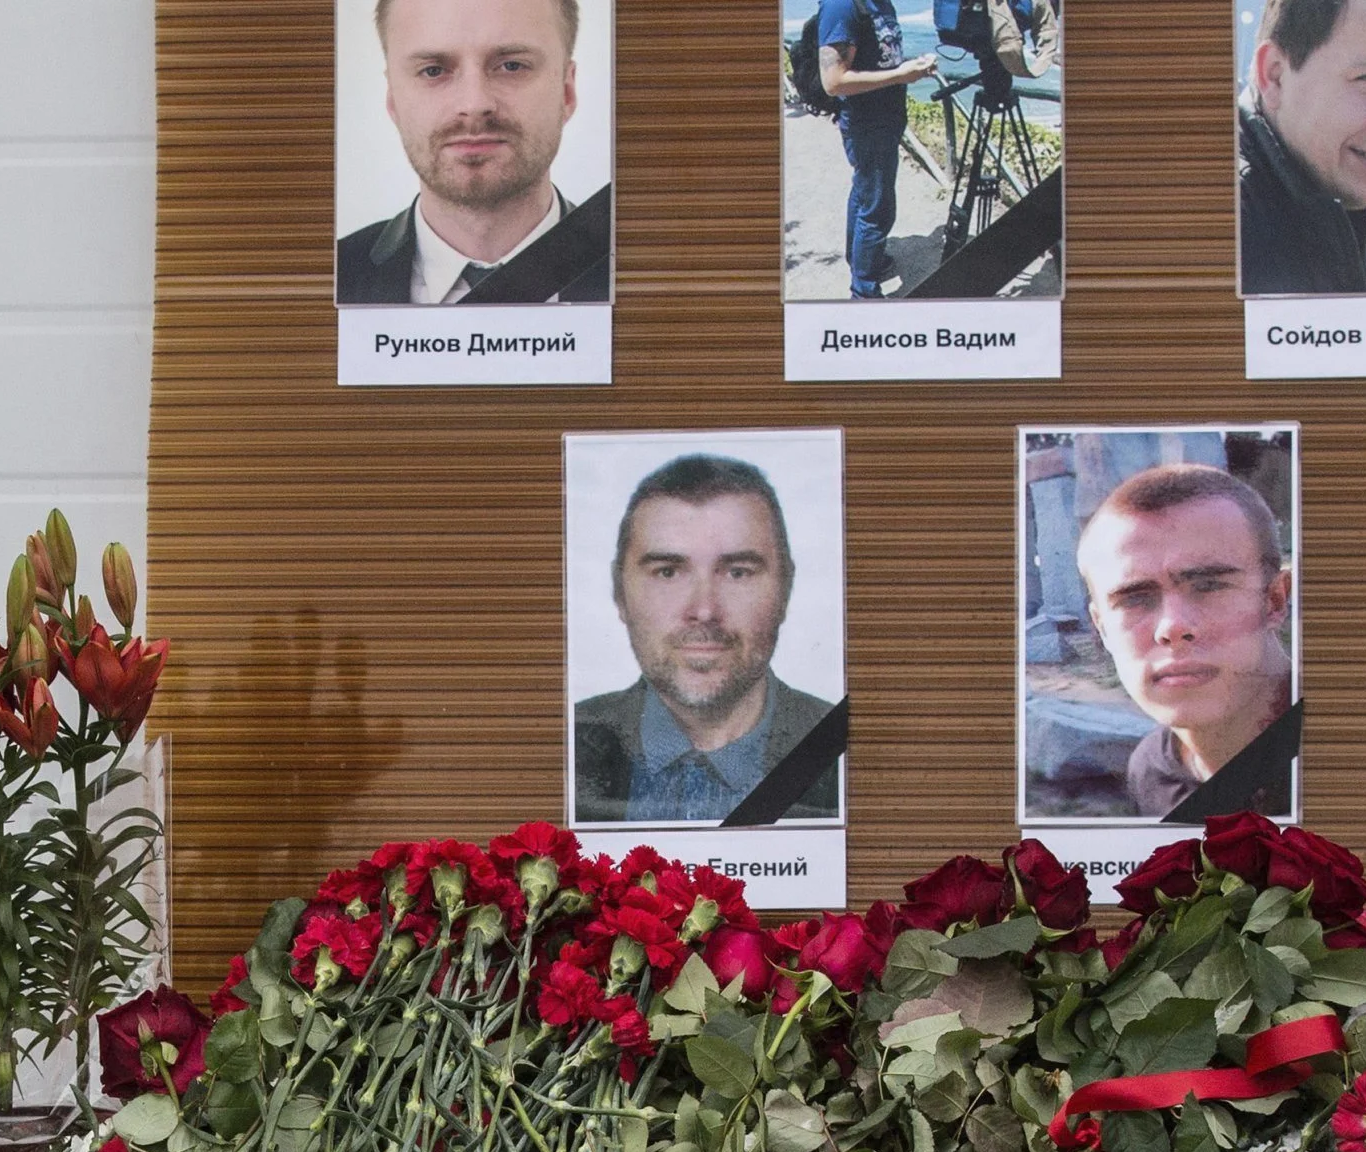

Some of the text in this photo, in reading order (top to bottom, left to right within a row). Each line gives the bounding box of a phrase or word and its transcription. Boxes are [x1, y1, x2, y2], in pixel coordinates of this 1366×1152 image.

[375, 332, 576, 358] Рунков Дмитрий
[820, 328, 1016, 353] Денисов Вадим
[1267, 325, 1363, 348] Сойдов
[707, 856, 808, 877] Евгений
